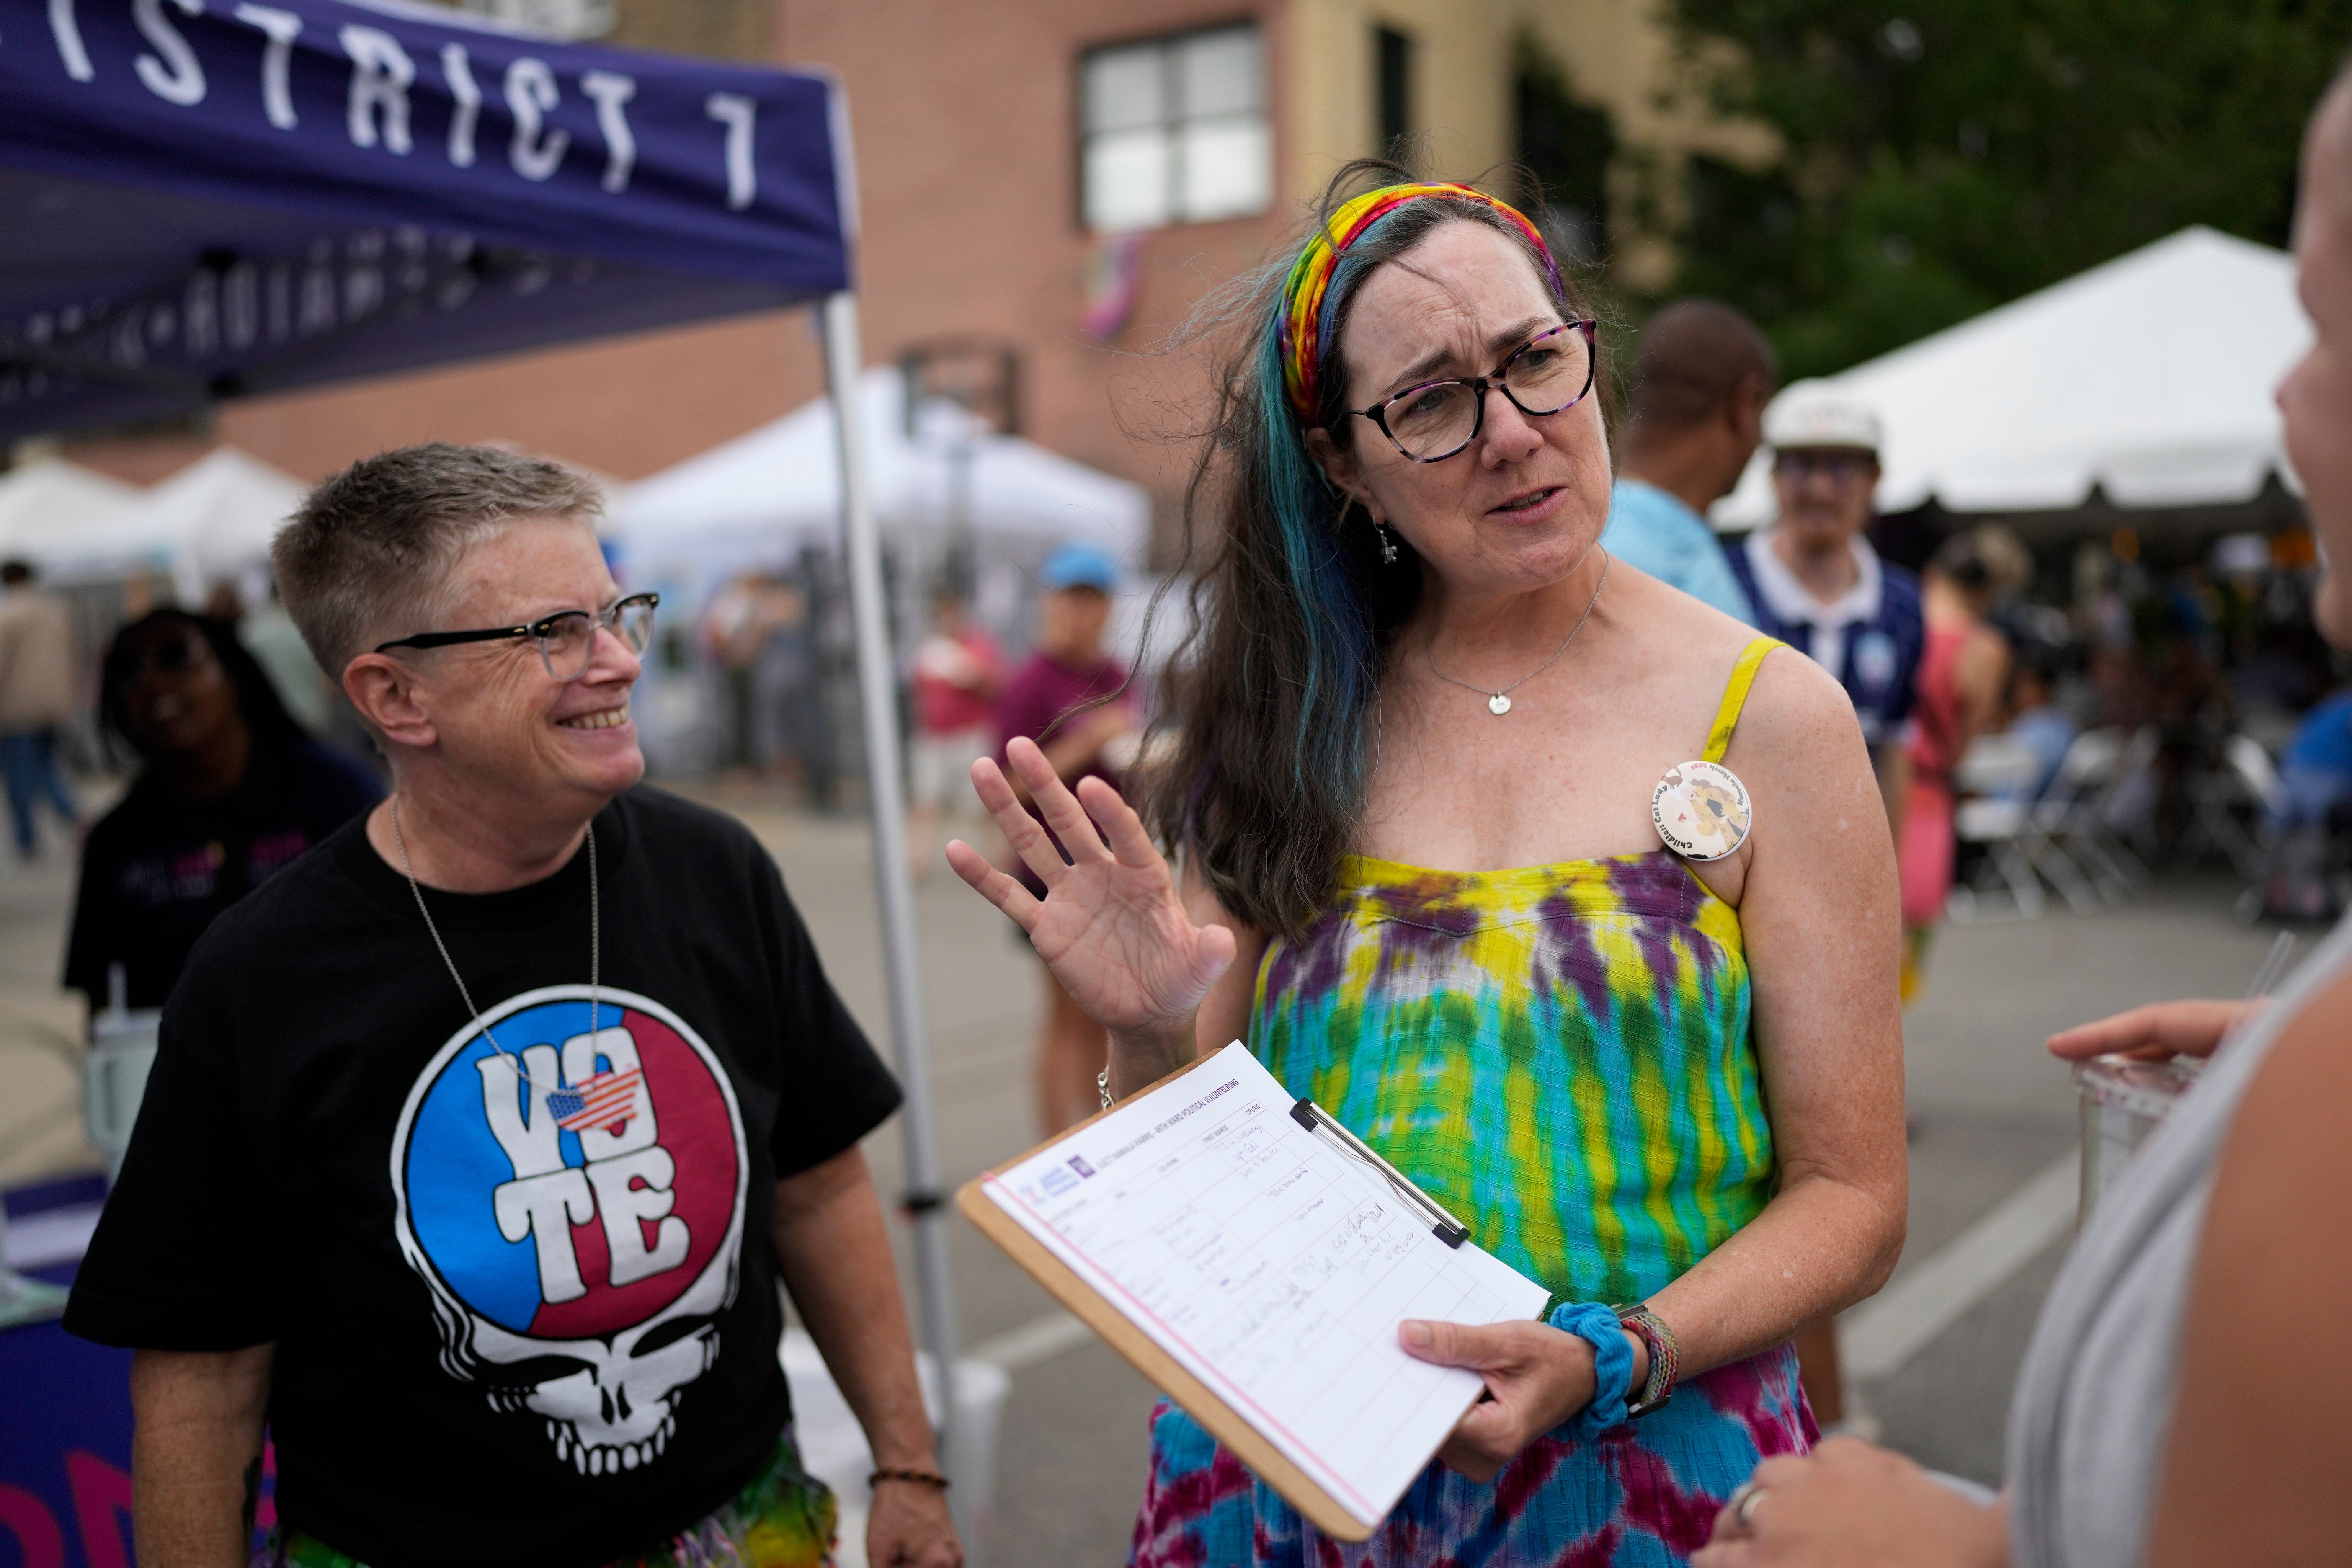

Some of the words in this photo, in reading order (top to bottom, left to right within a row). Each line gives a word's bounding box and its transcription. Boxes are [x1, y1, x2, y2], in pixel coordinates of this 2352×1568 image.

[707, 91, 756, 207] 7
[1709, 764, 1730, 780] Harris
[1652, 784, 1668, 805] Lady
[1730, 778, 1744, 806] Kamala
[1653, 807, 1662, 823] Cat
[1659, 824, 1692, 849] Childless
[1168, 1112, 1184, 1126] WARD
[1182, 1099, 1207, 1117] POLITICAL
[1202, 1078, 1239, 1103] VOLUNTEERING
[1214, 1125, 1229, 1136] ADDRESS
